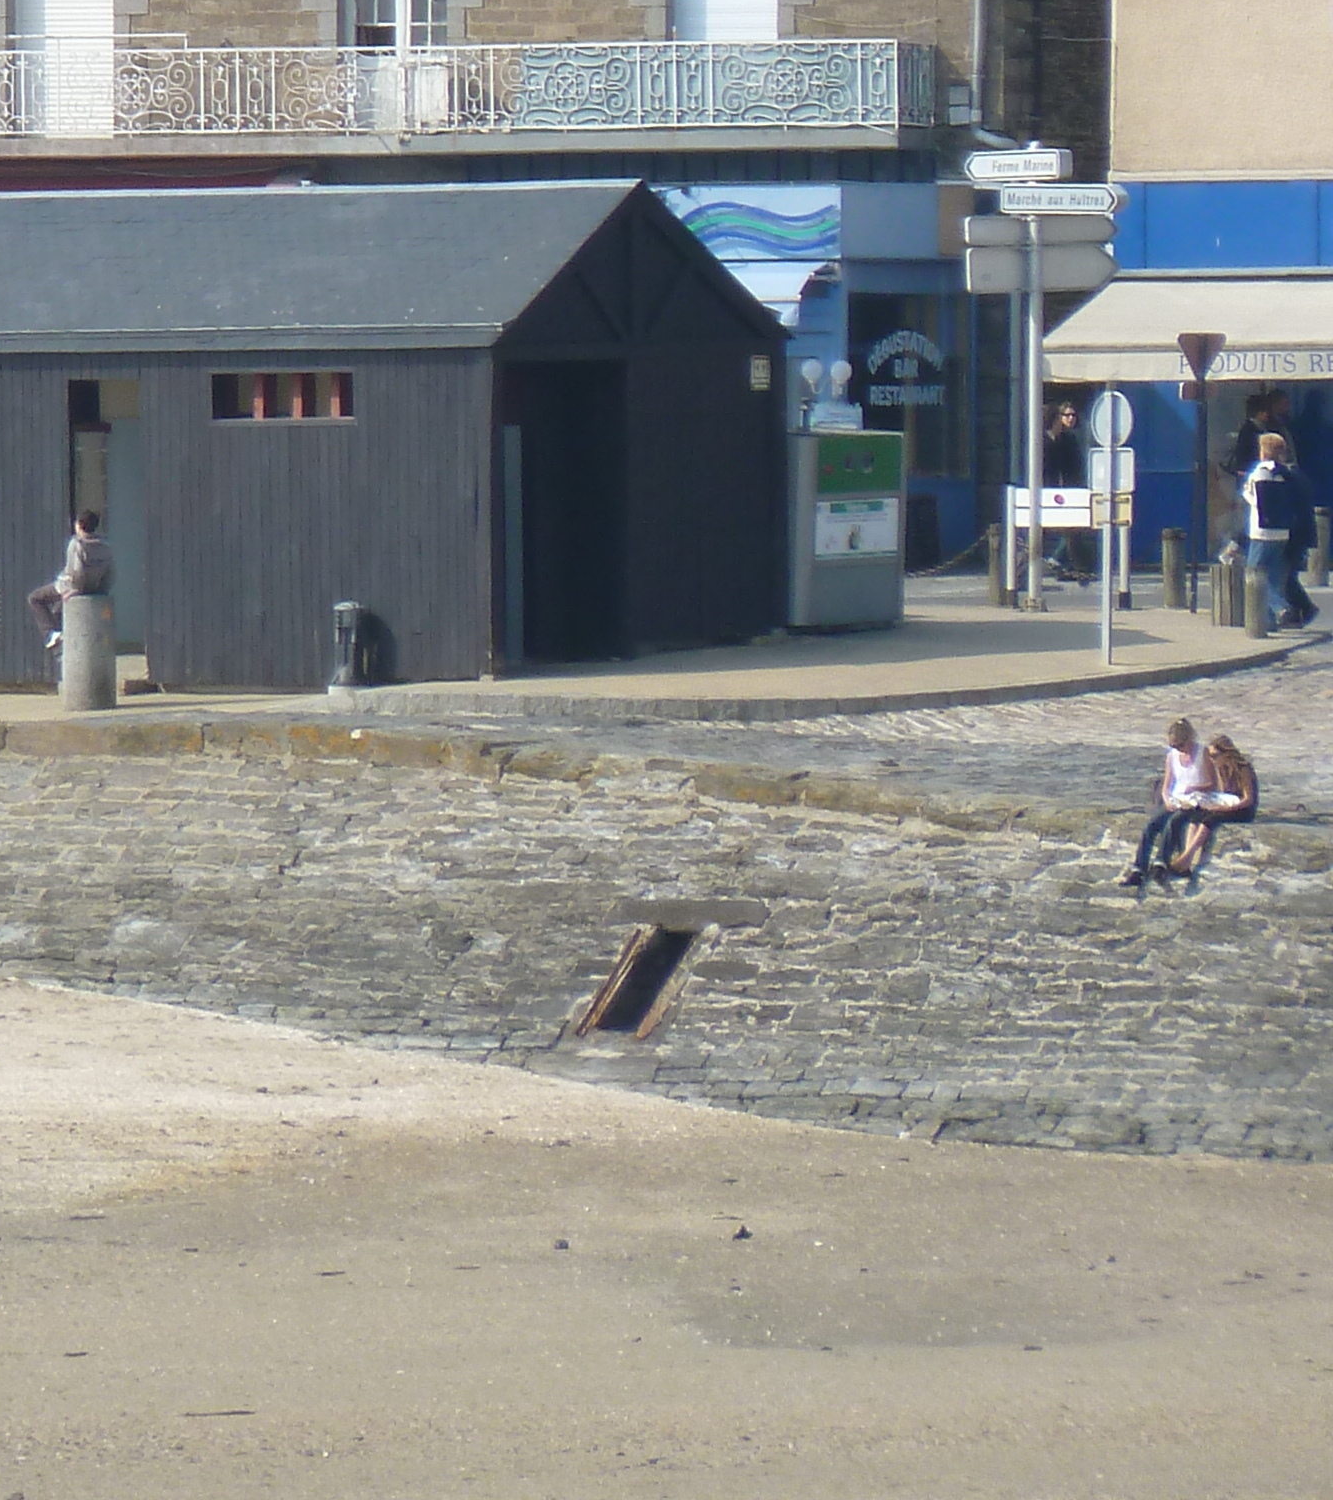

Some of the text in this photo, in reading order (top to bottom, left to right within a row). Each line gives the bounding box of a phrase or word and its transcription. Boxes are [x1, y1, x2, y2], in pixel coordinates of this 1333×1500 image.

[991, 158, 1054, 172] Ferme Marine
[1006, 192, 1043, 206] Marché
[1047, 196, 1064, 205] aux
[893, 358, 919, 379] BAR
[1179, 352, 1297, 374] PODUITS
[869, 384, 946, 407] RESTAURANT
